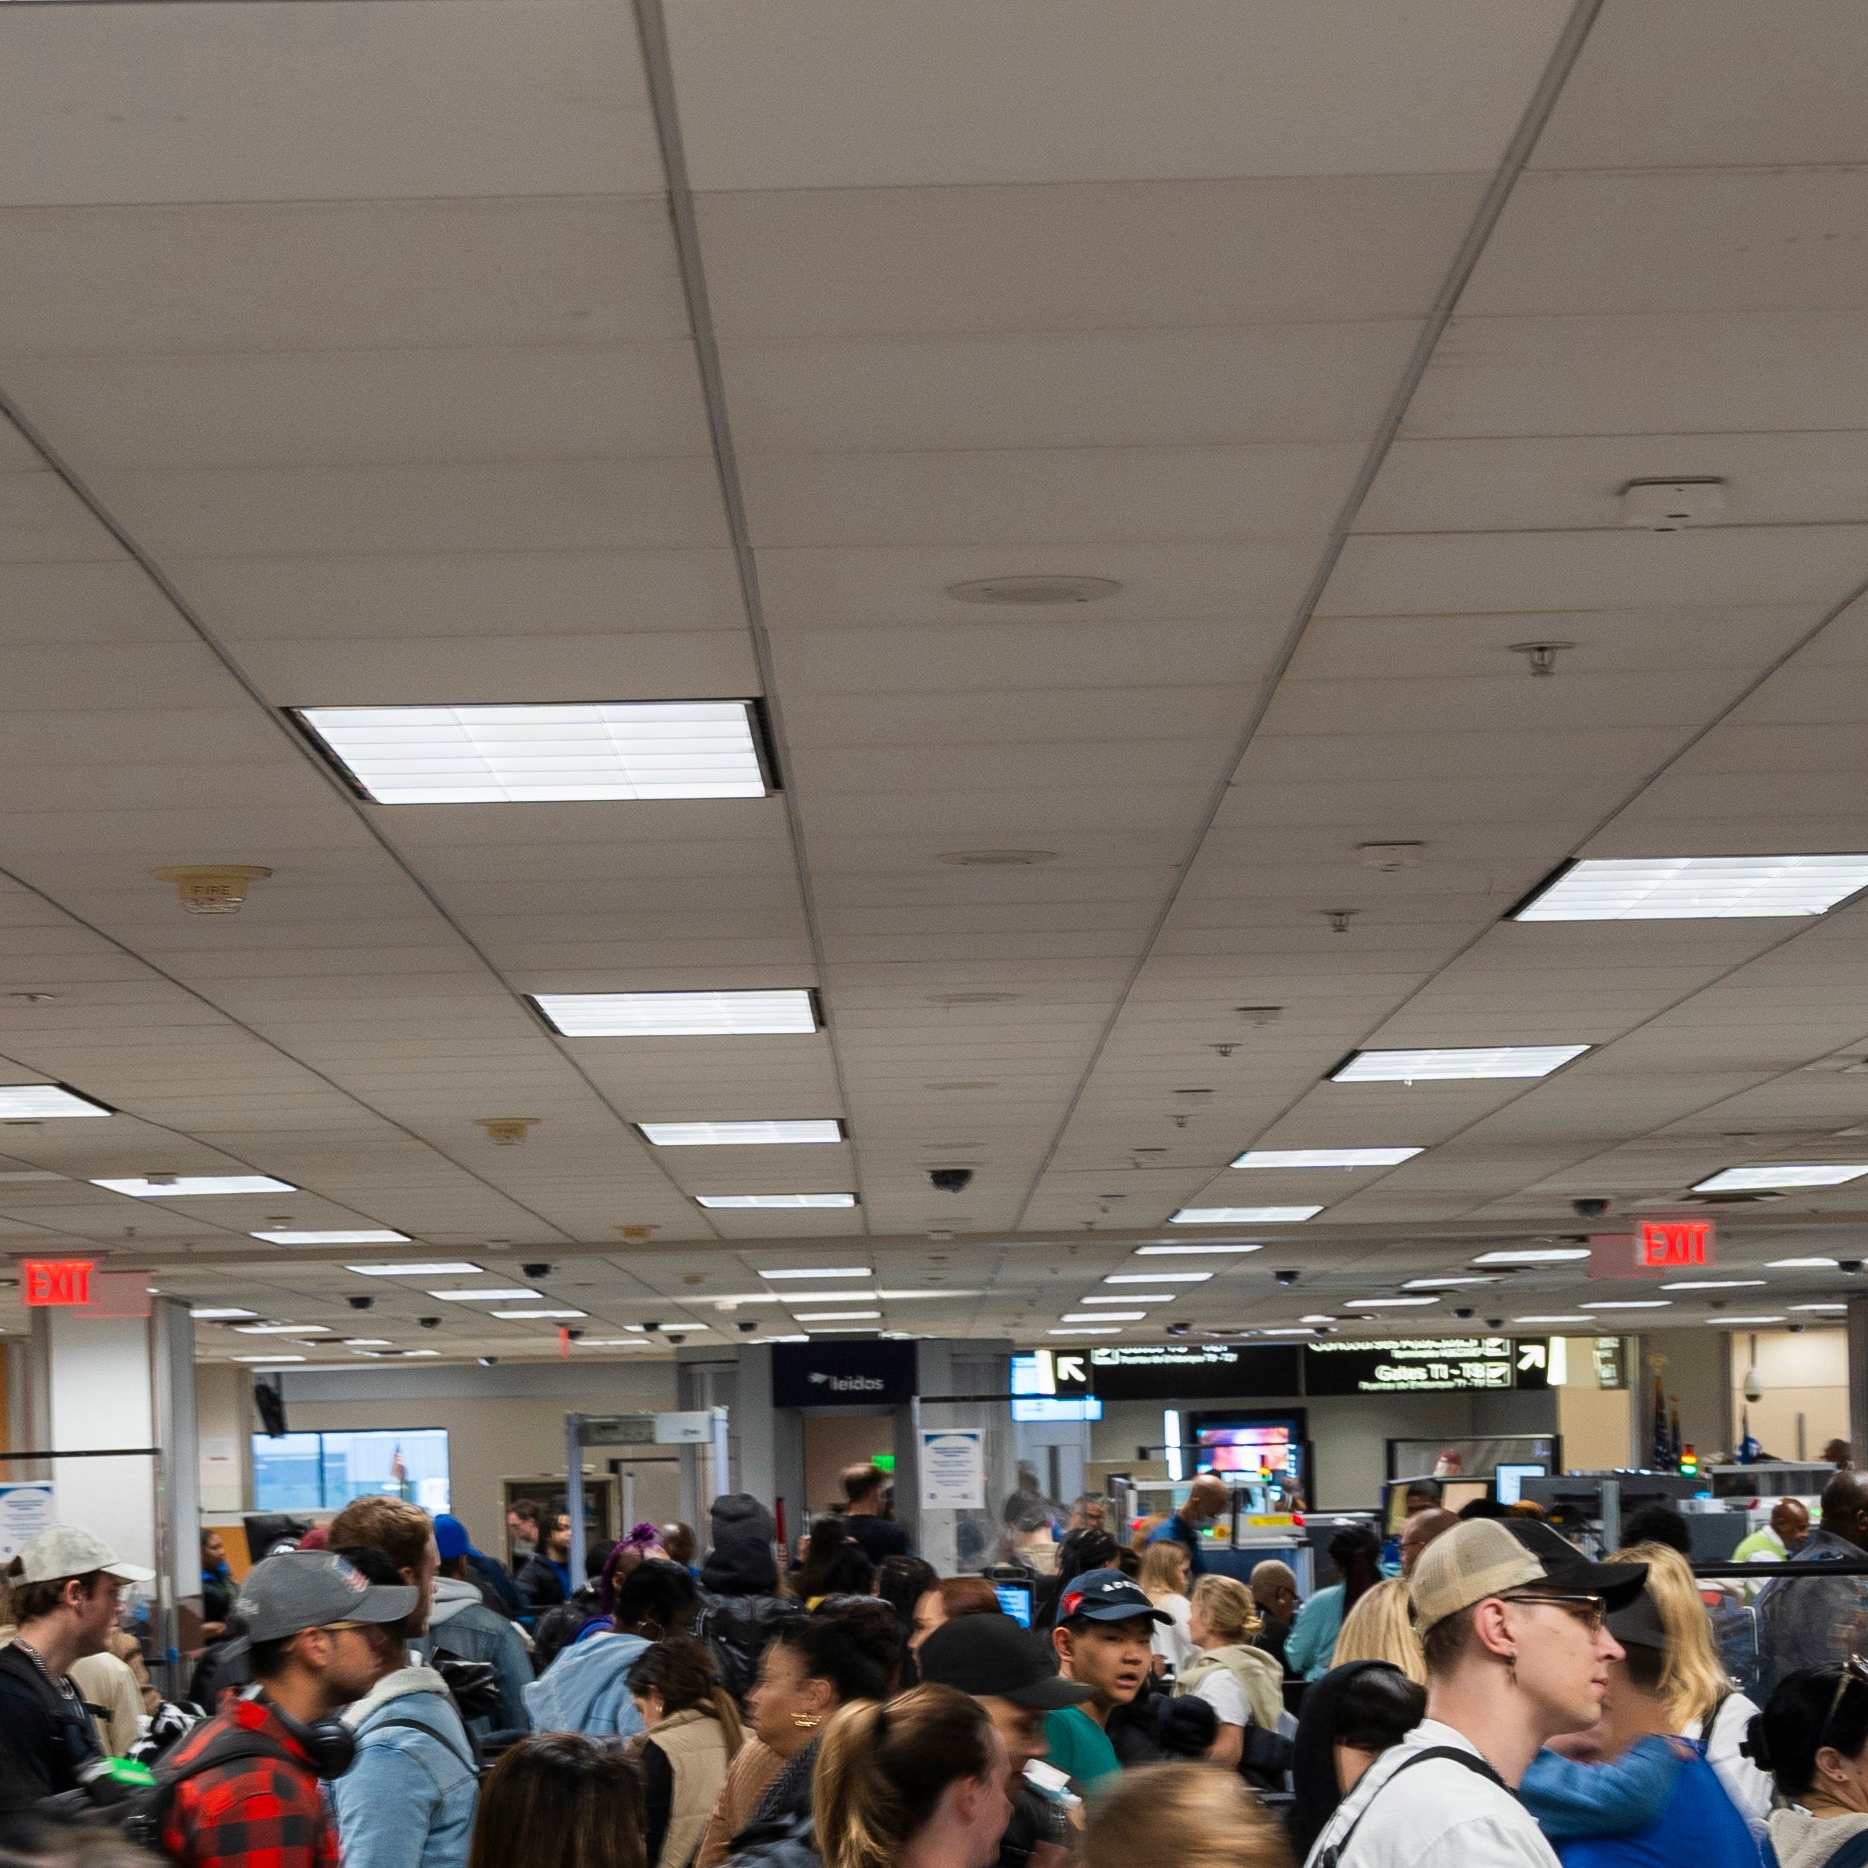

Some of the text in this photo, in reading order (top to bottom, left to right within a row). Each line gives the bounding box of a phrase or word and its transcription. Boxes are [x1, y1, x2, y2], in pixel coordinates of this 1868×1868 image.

[1642, 1222, 1709, 1265] EXIT
[25, 1261, 94, 1305] EXIT
[829, 1375, 884, 1391] leidos
[1375, 1364, 1428, 1381] Gates
